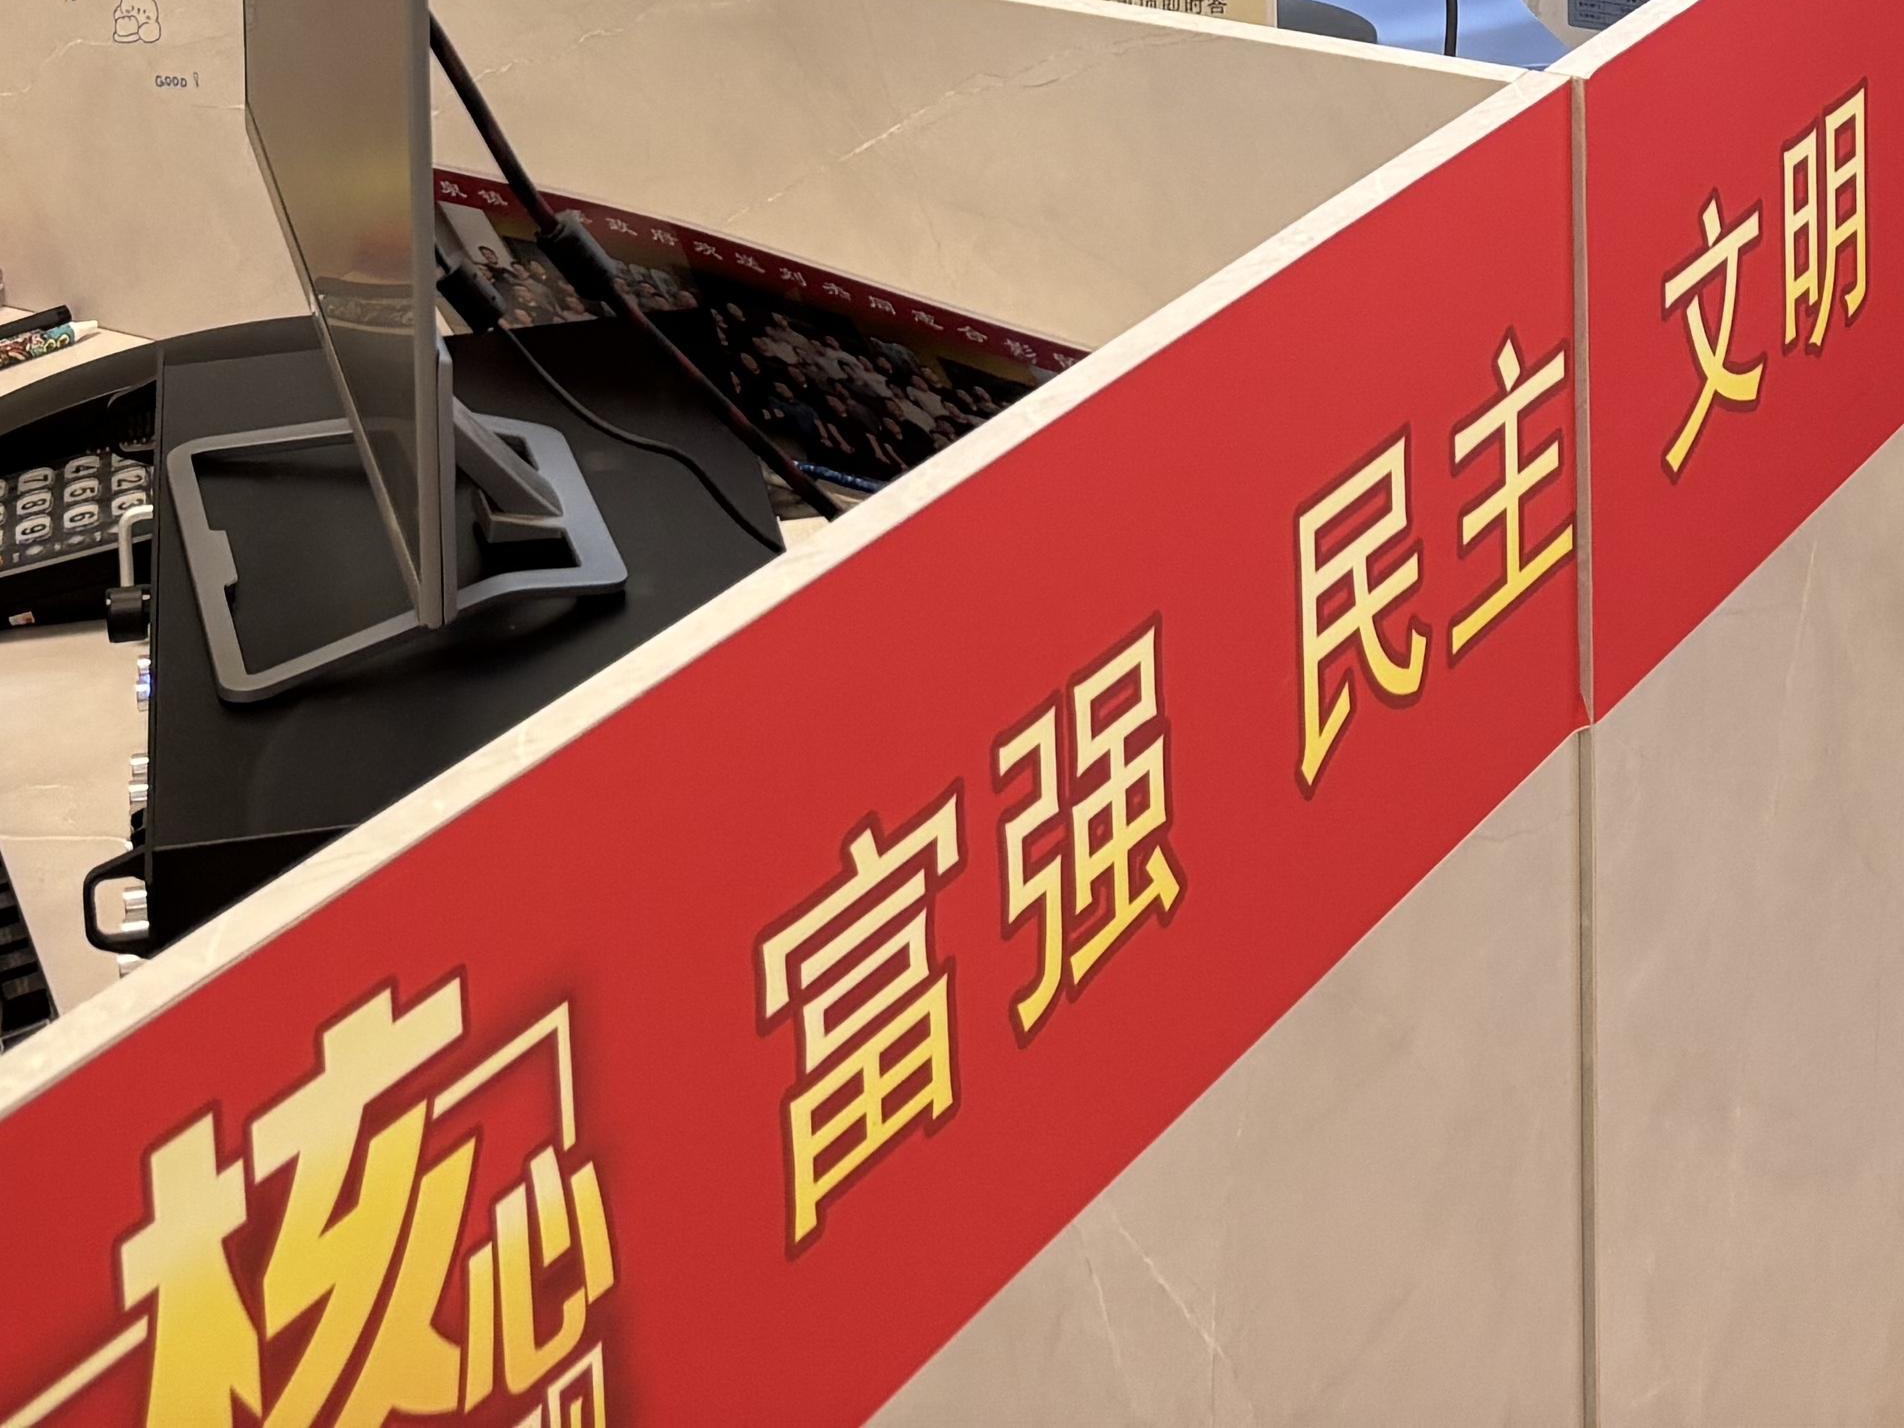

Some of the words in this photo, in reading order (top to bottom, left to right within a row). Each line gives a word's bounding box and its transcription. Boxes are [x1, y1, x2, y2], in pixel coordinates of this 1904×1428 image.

[758, 624, 1183, 1249] 富强
[1291, 331, 1574, 792] 民主
[1660, 83, 1871, 475] 文明
[117, 968, 617, 1428] 核心
